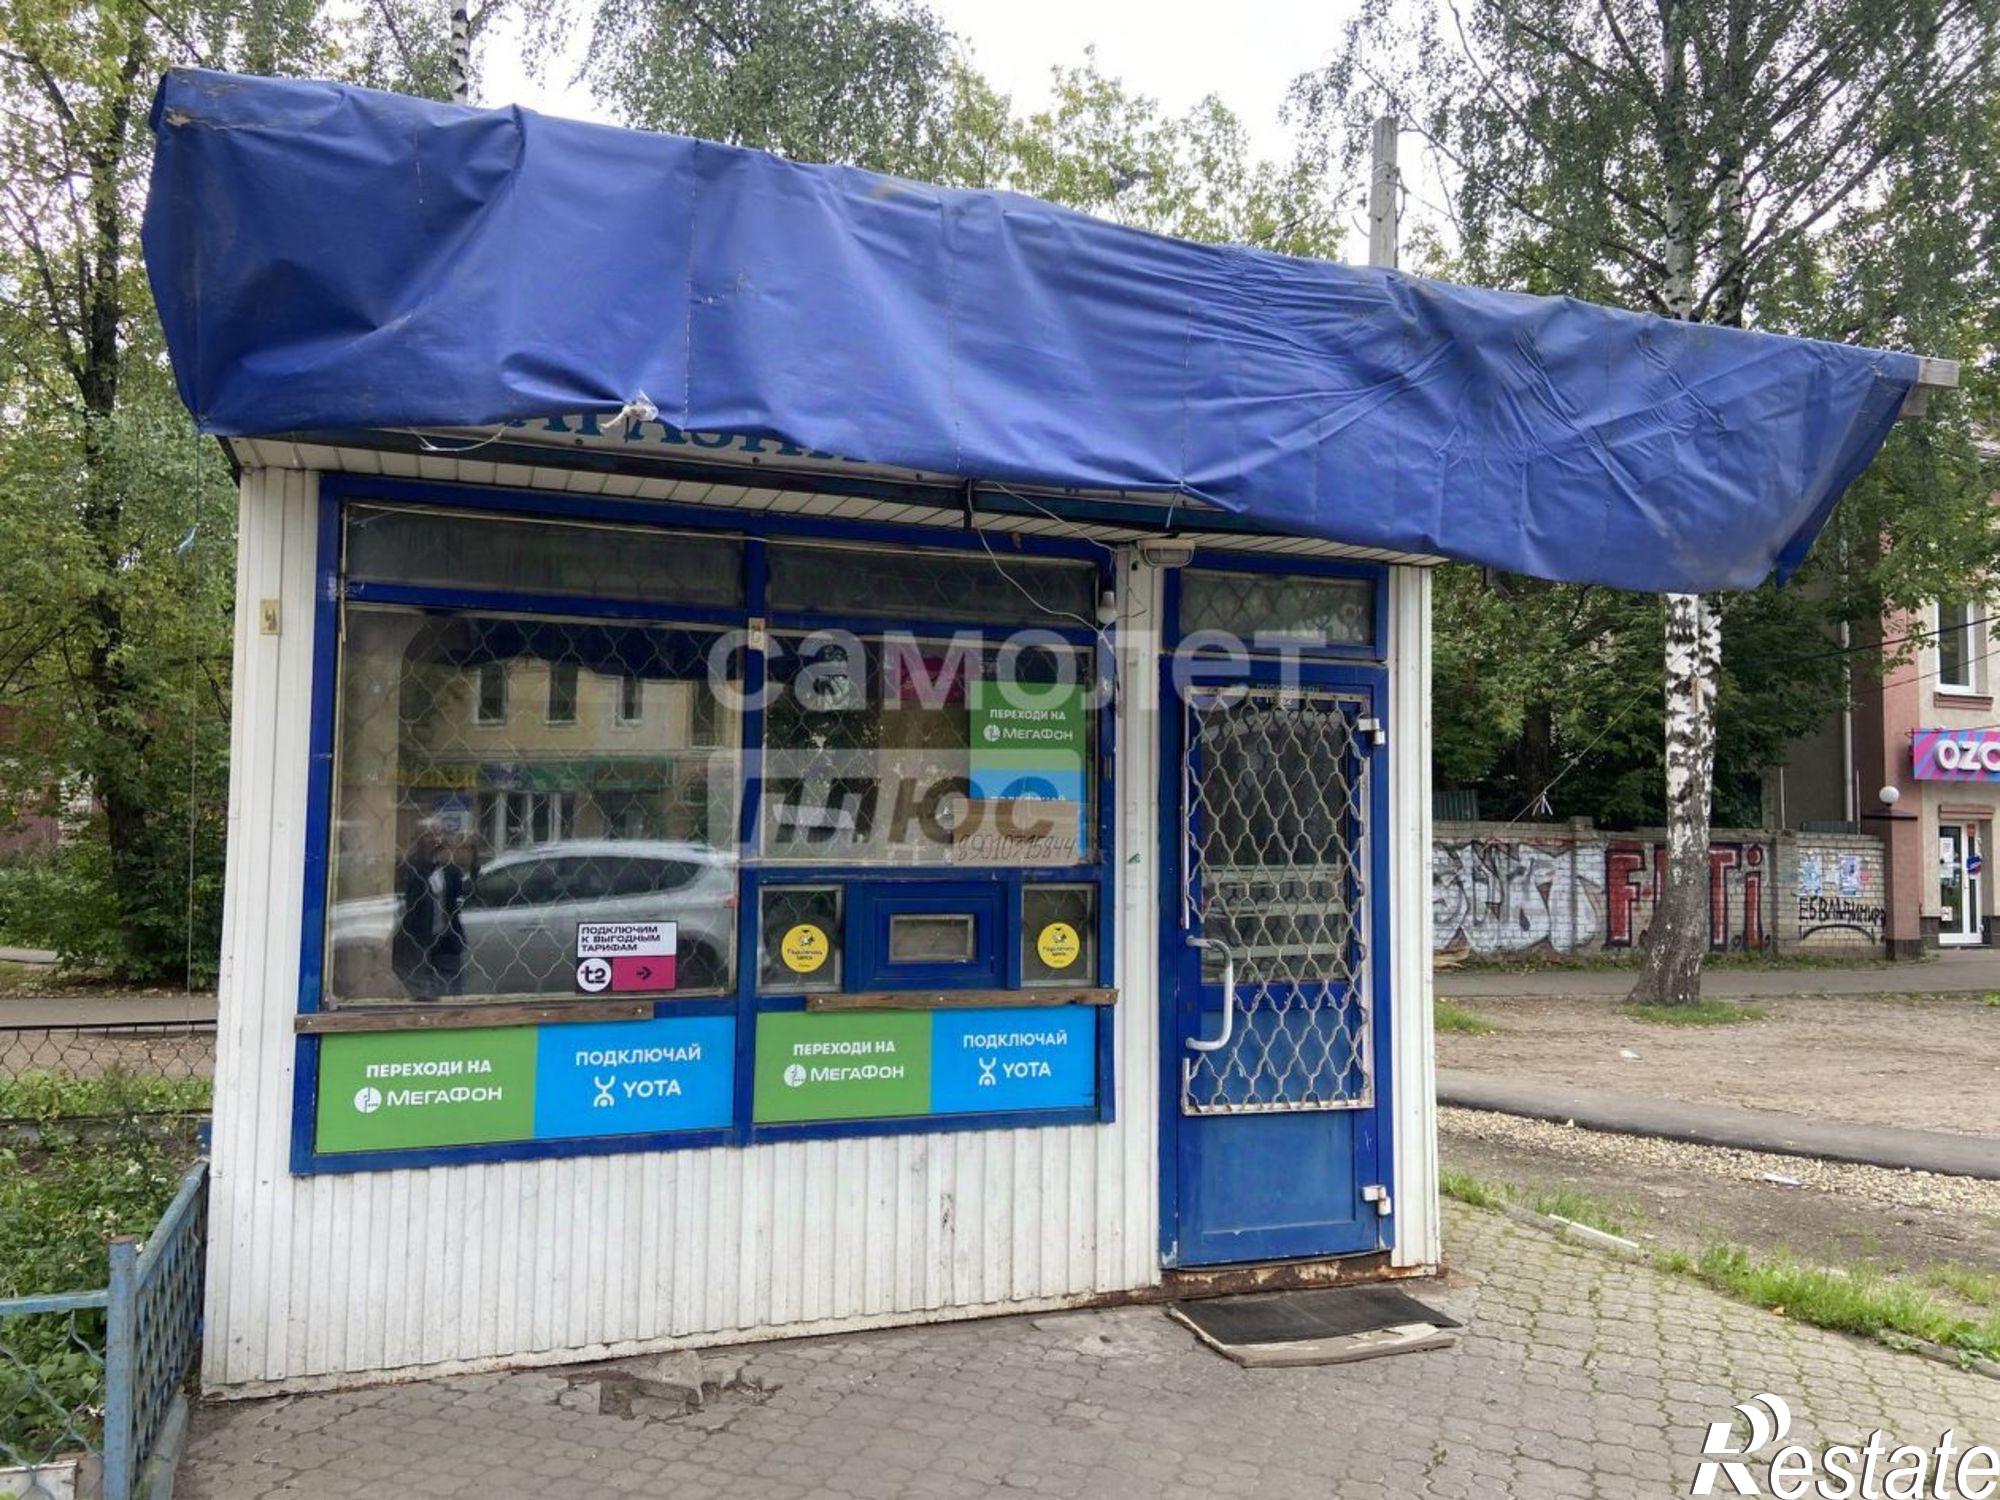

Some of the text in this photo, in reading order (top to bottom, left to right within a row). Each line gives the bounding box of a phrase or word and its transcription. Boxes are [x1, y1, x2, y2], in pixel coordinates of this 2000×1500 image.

[989, 708, 1067, 721] ПЕРЕХОДИ НА
[581, 925, 659, 935] ПОДКЛЮЧИМ
[581, 934, 661, 944] К ВЫГОДНЫМ
[581, 943, 638, 952] ТАРИФАМ
[581, 965, 606, 984] t2
[793, 1040, 896, 1057] ПЕРЕХОДИ НА
[962, 1029, 1068, 1050] ПОДКЛЮЧАЙ
[575, 1042, 702, 1066] ПОДКЛЮЧАЙ
[366, 1059, 492, 1078] ПЕРЕХОДИ НА
[1002, 1061, 1051, 1080] YOTA
[623, 1078, 682, 1098] YOTA
